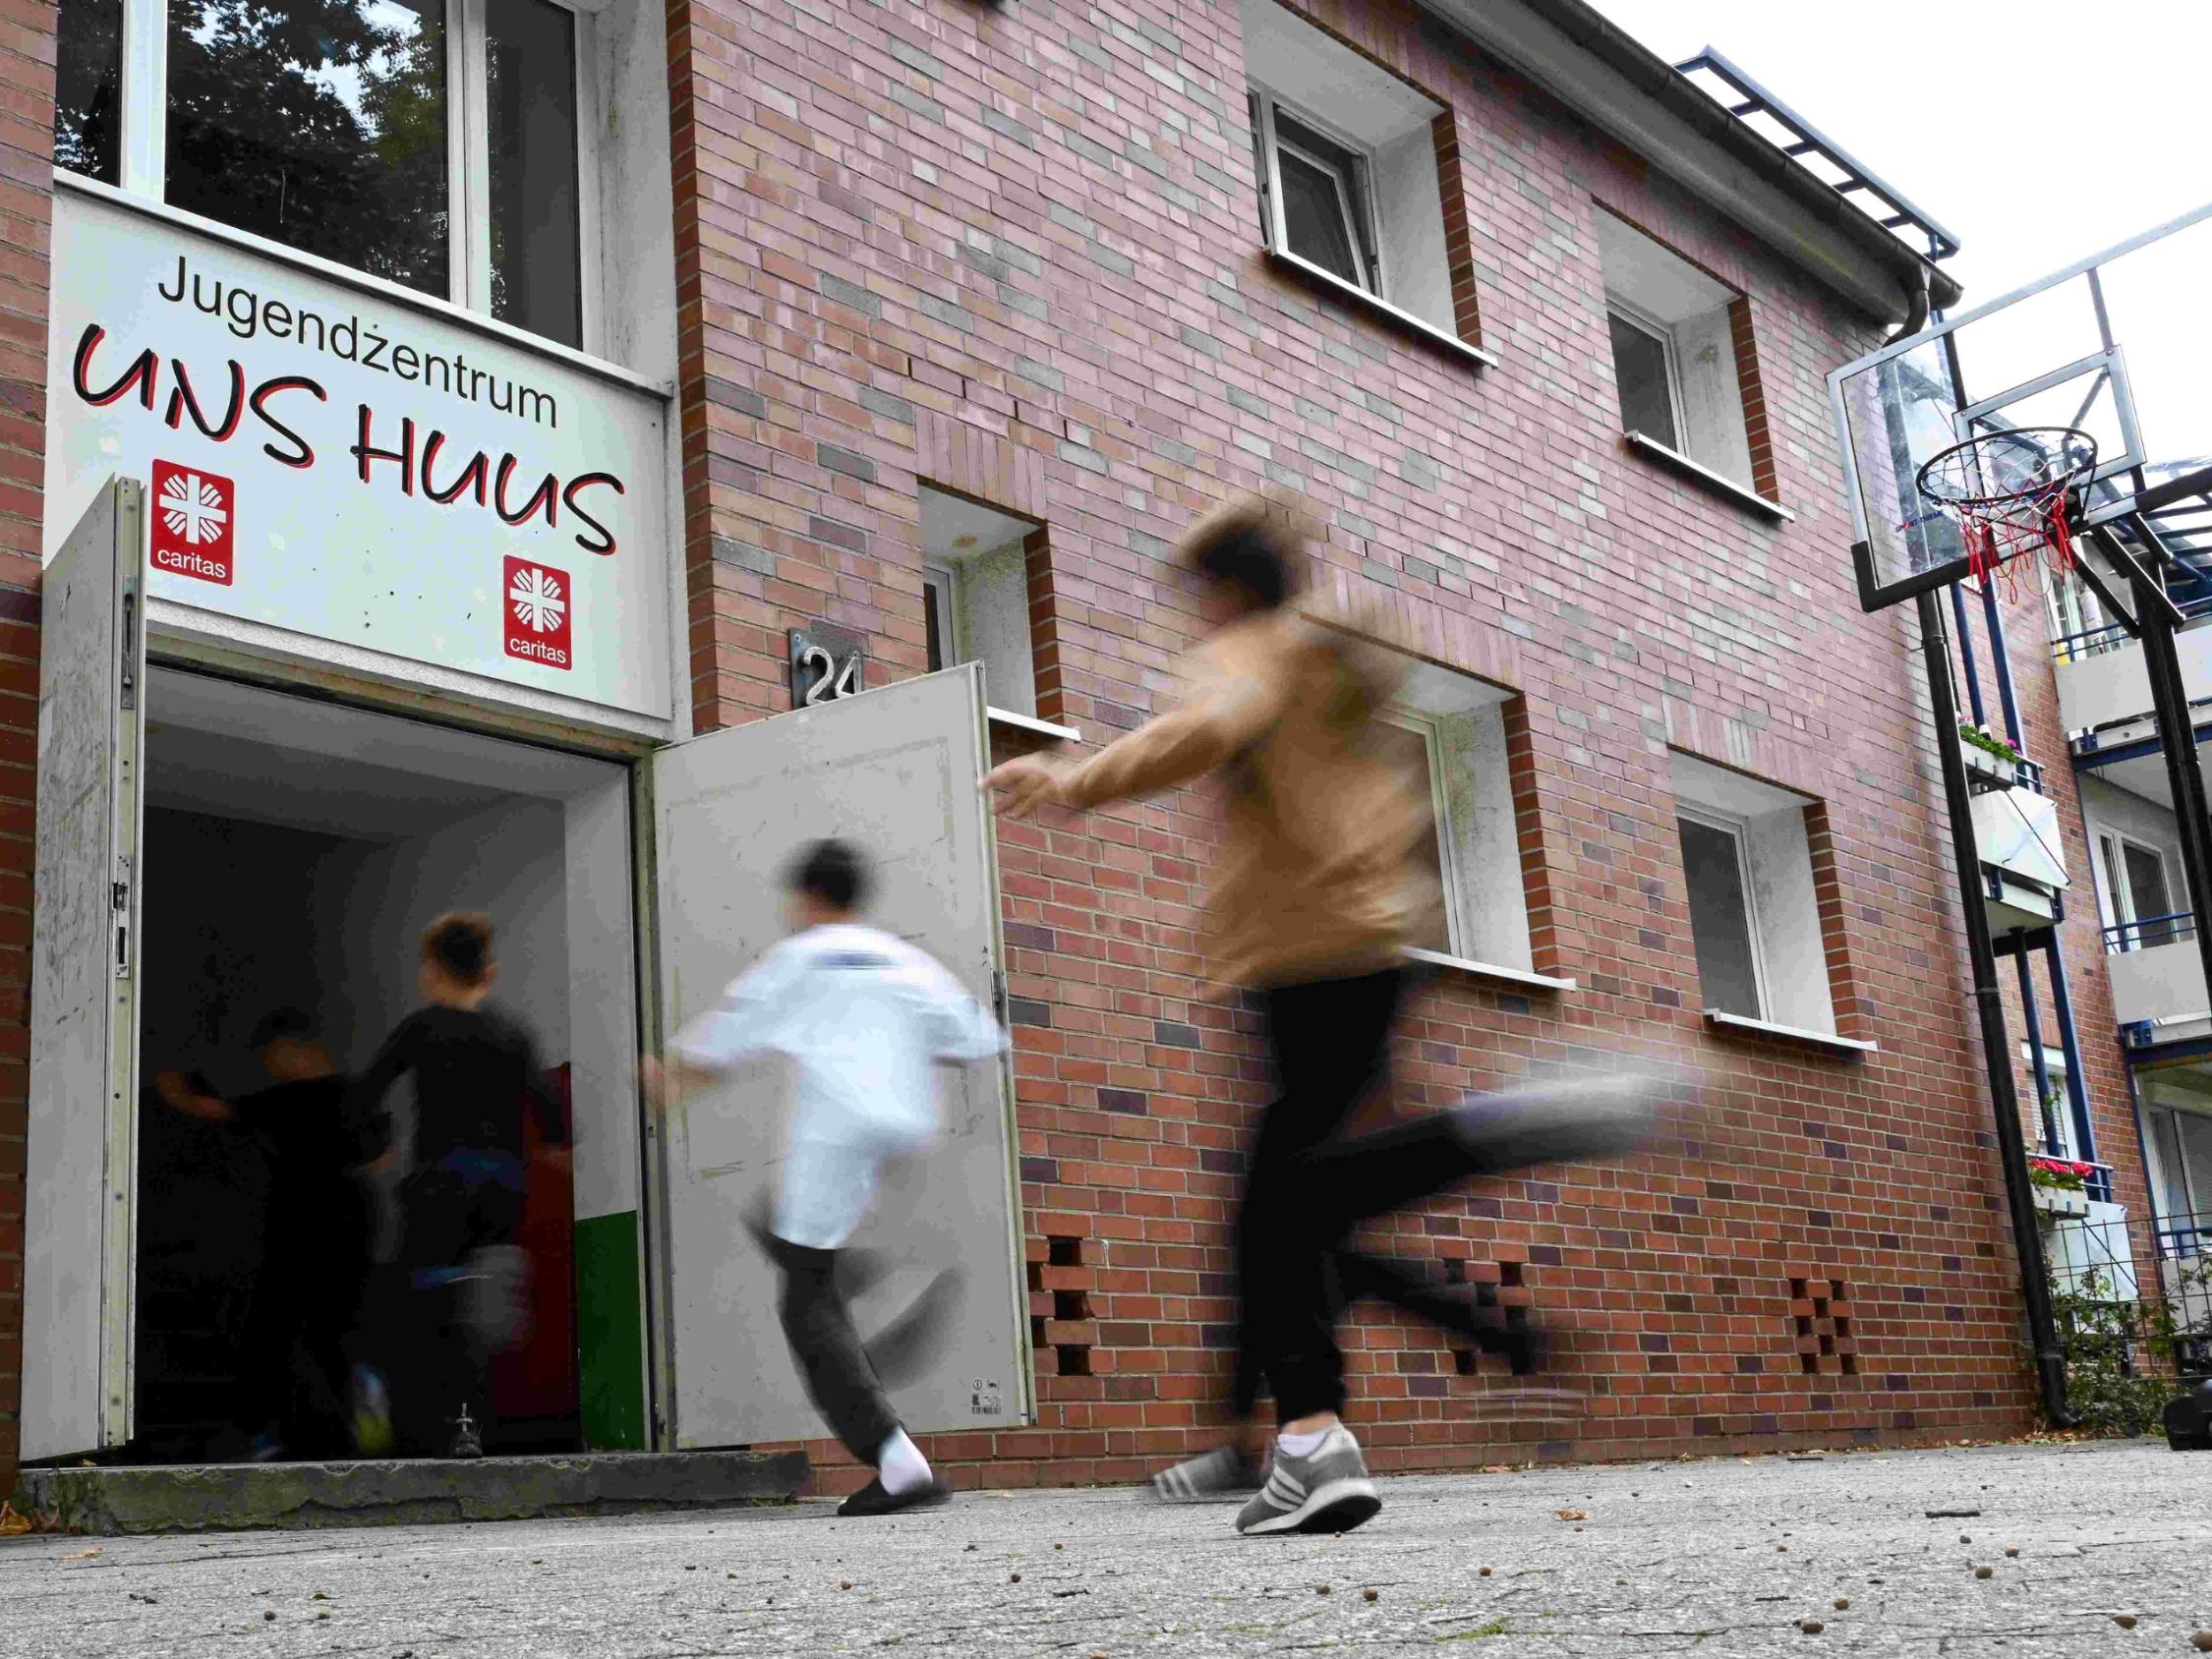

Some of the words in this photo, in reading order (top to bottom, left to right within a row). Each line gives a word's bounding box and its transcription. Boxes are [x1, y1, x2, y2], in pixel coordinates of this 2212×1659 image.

[157, 255, 556, 429] Jugendzentrum
[73, 323, 327, 469] UNS
[349, 403, 625, 556] HUUS
[157, 549, 227, 579] caritas
[509, 638, 567, 664] caritas
[803, 646, 861, 706] 24
